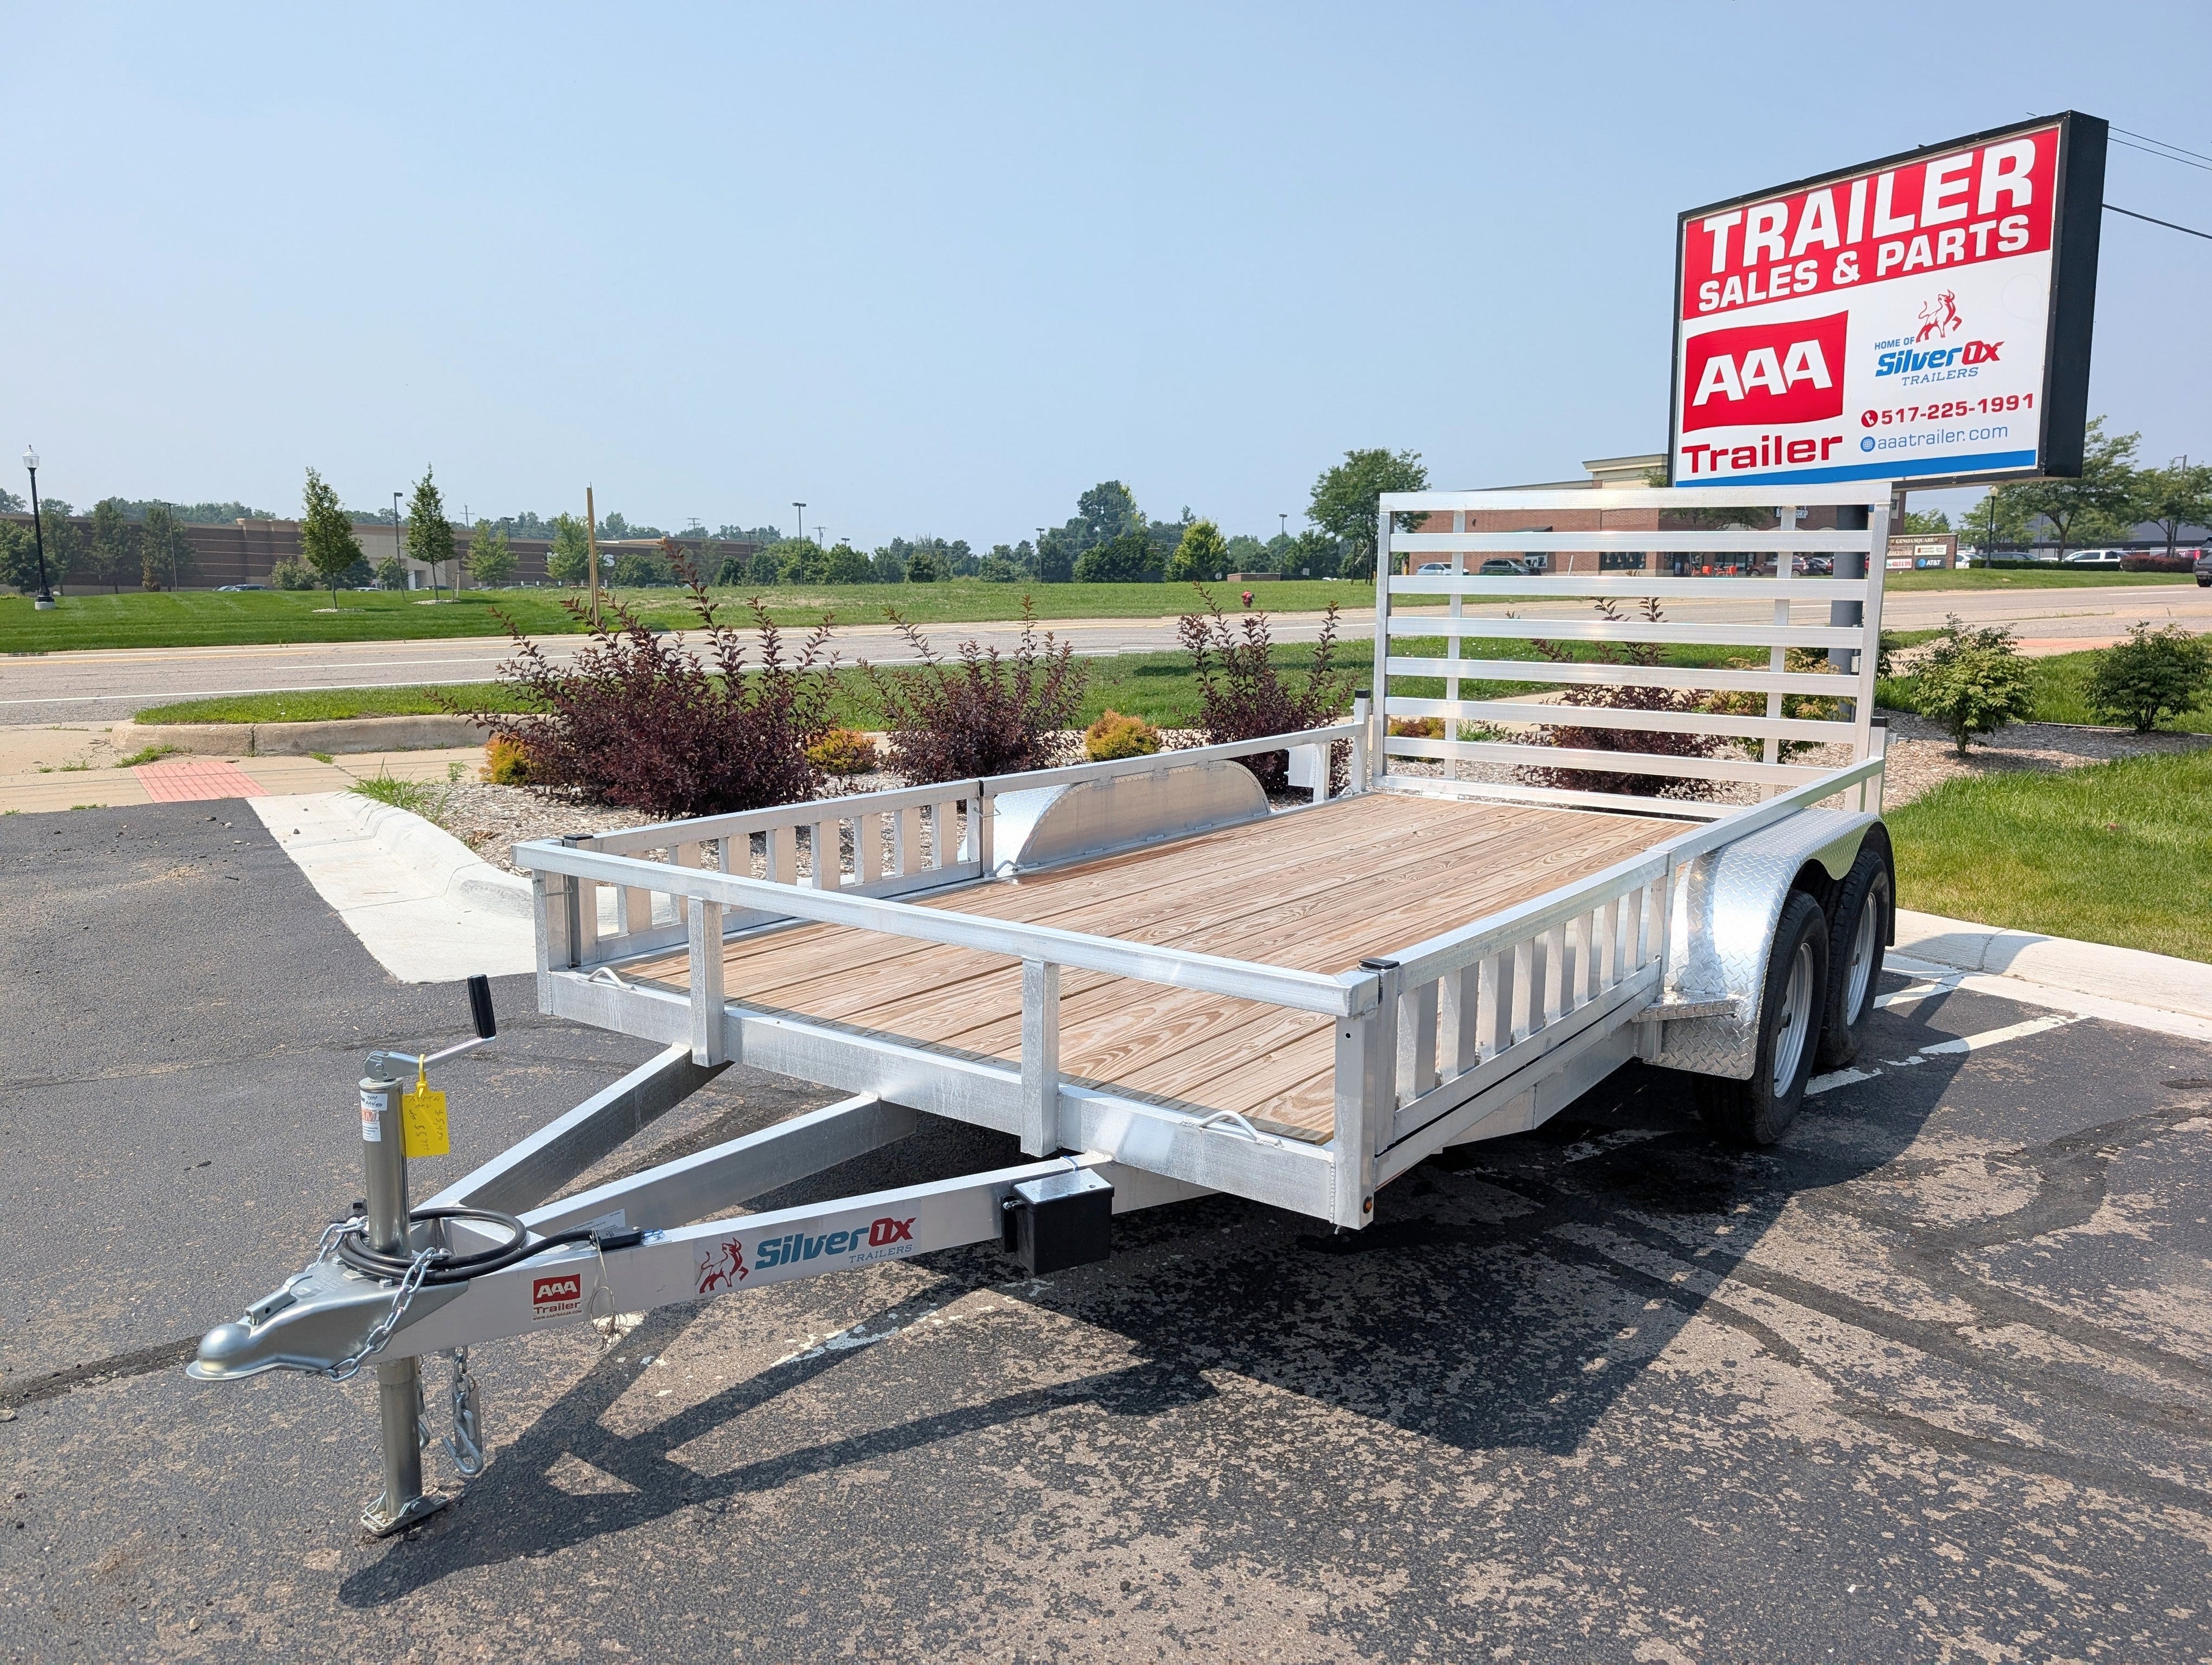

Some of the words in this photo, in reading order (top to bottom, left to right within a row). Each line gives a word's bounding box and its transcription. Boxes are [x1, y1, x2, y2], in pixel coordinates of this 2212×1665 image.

[1703, 138, 2036, 274] TRAILER
[1699, 259, 1817, 312] SALES
[1832, 251, 1861, 285] &
[1876, 214, 2029, 276] PARTS
[1874, 339, 1900, 350] HOME
[1903, 336, 1915, 346] OF
[1692, 339, 1833, 407] AAA
[1902, 366, 1979, 386] TRAILERS
[1881, 393, 2033, 425] 517-225-1991
[1878, 426, 2008, 449] aaatrailer.com
[1681, 435, 1843, 473] Trailer
[849, 1244, 913, 1264] TRAILERS
[536, 1281, 578, 1298] AAA
[533, 1302, 581, 1314] Trailer
